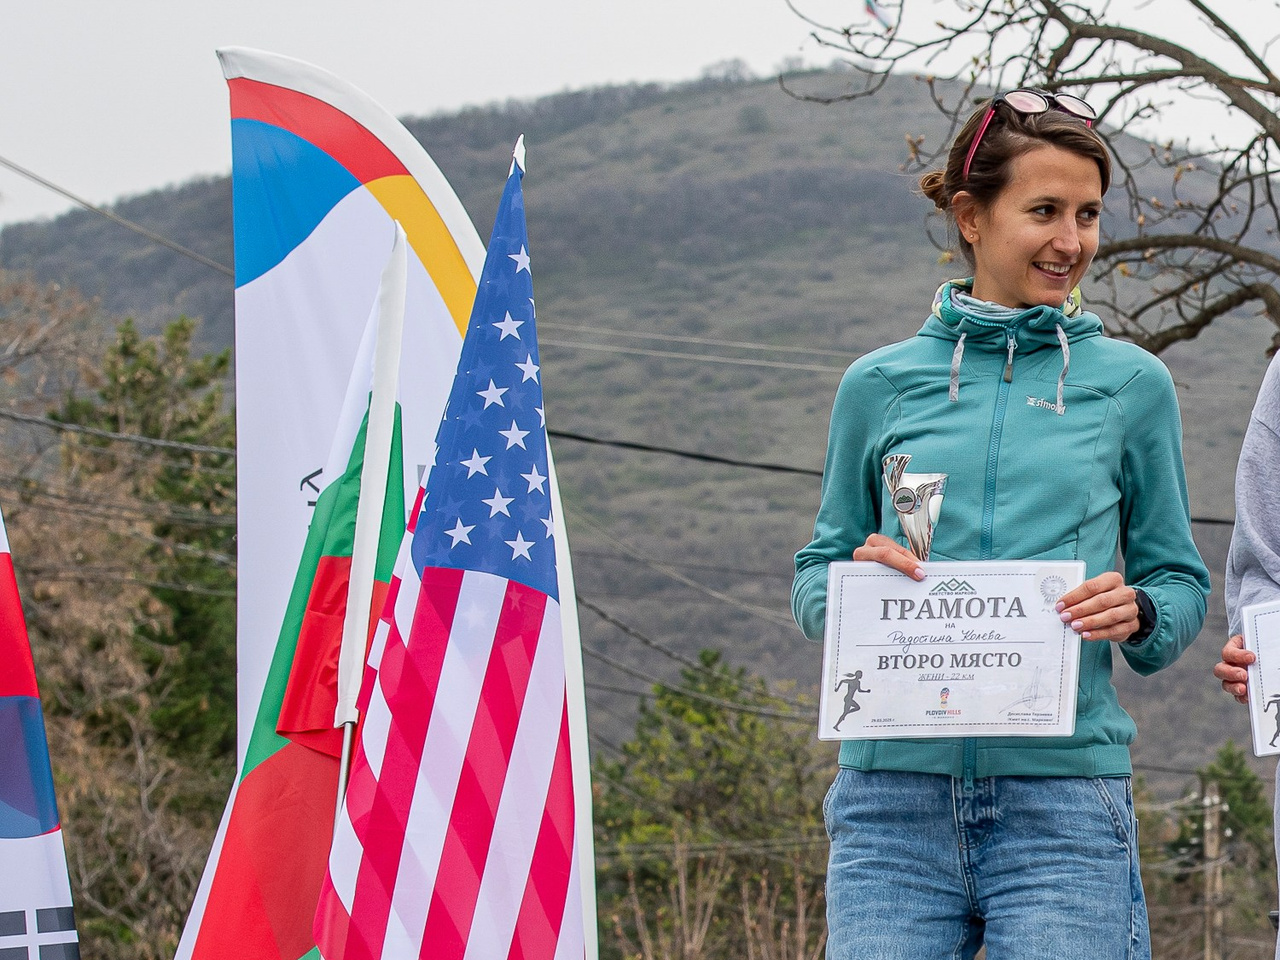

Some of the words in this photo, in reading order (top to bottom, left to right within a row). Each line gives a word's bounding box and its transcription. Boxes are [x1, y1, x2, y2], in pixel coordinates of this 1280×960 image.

[880, 596, 1027, 621] ГРАМОТА
[876, 654, 944, 670] ВТОРО
[949, 652, 1022, 668] МЯСТО
[918, 673, 945, 681] ЖЕНИ
